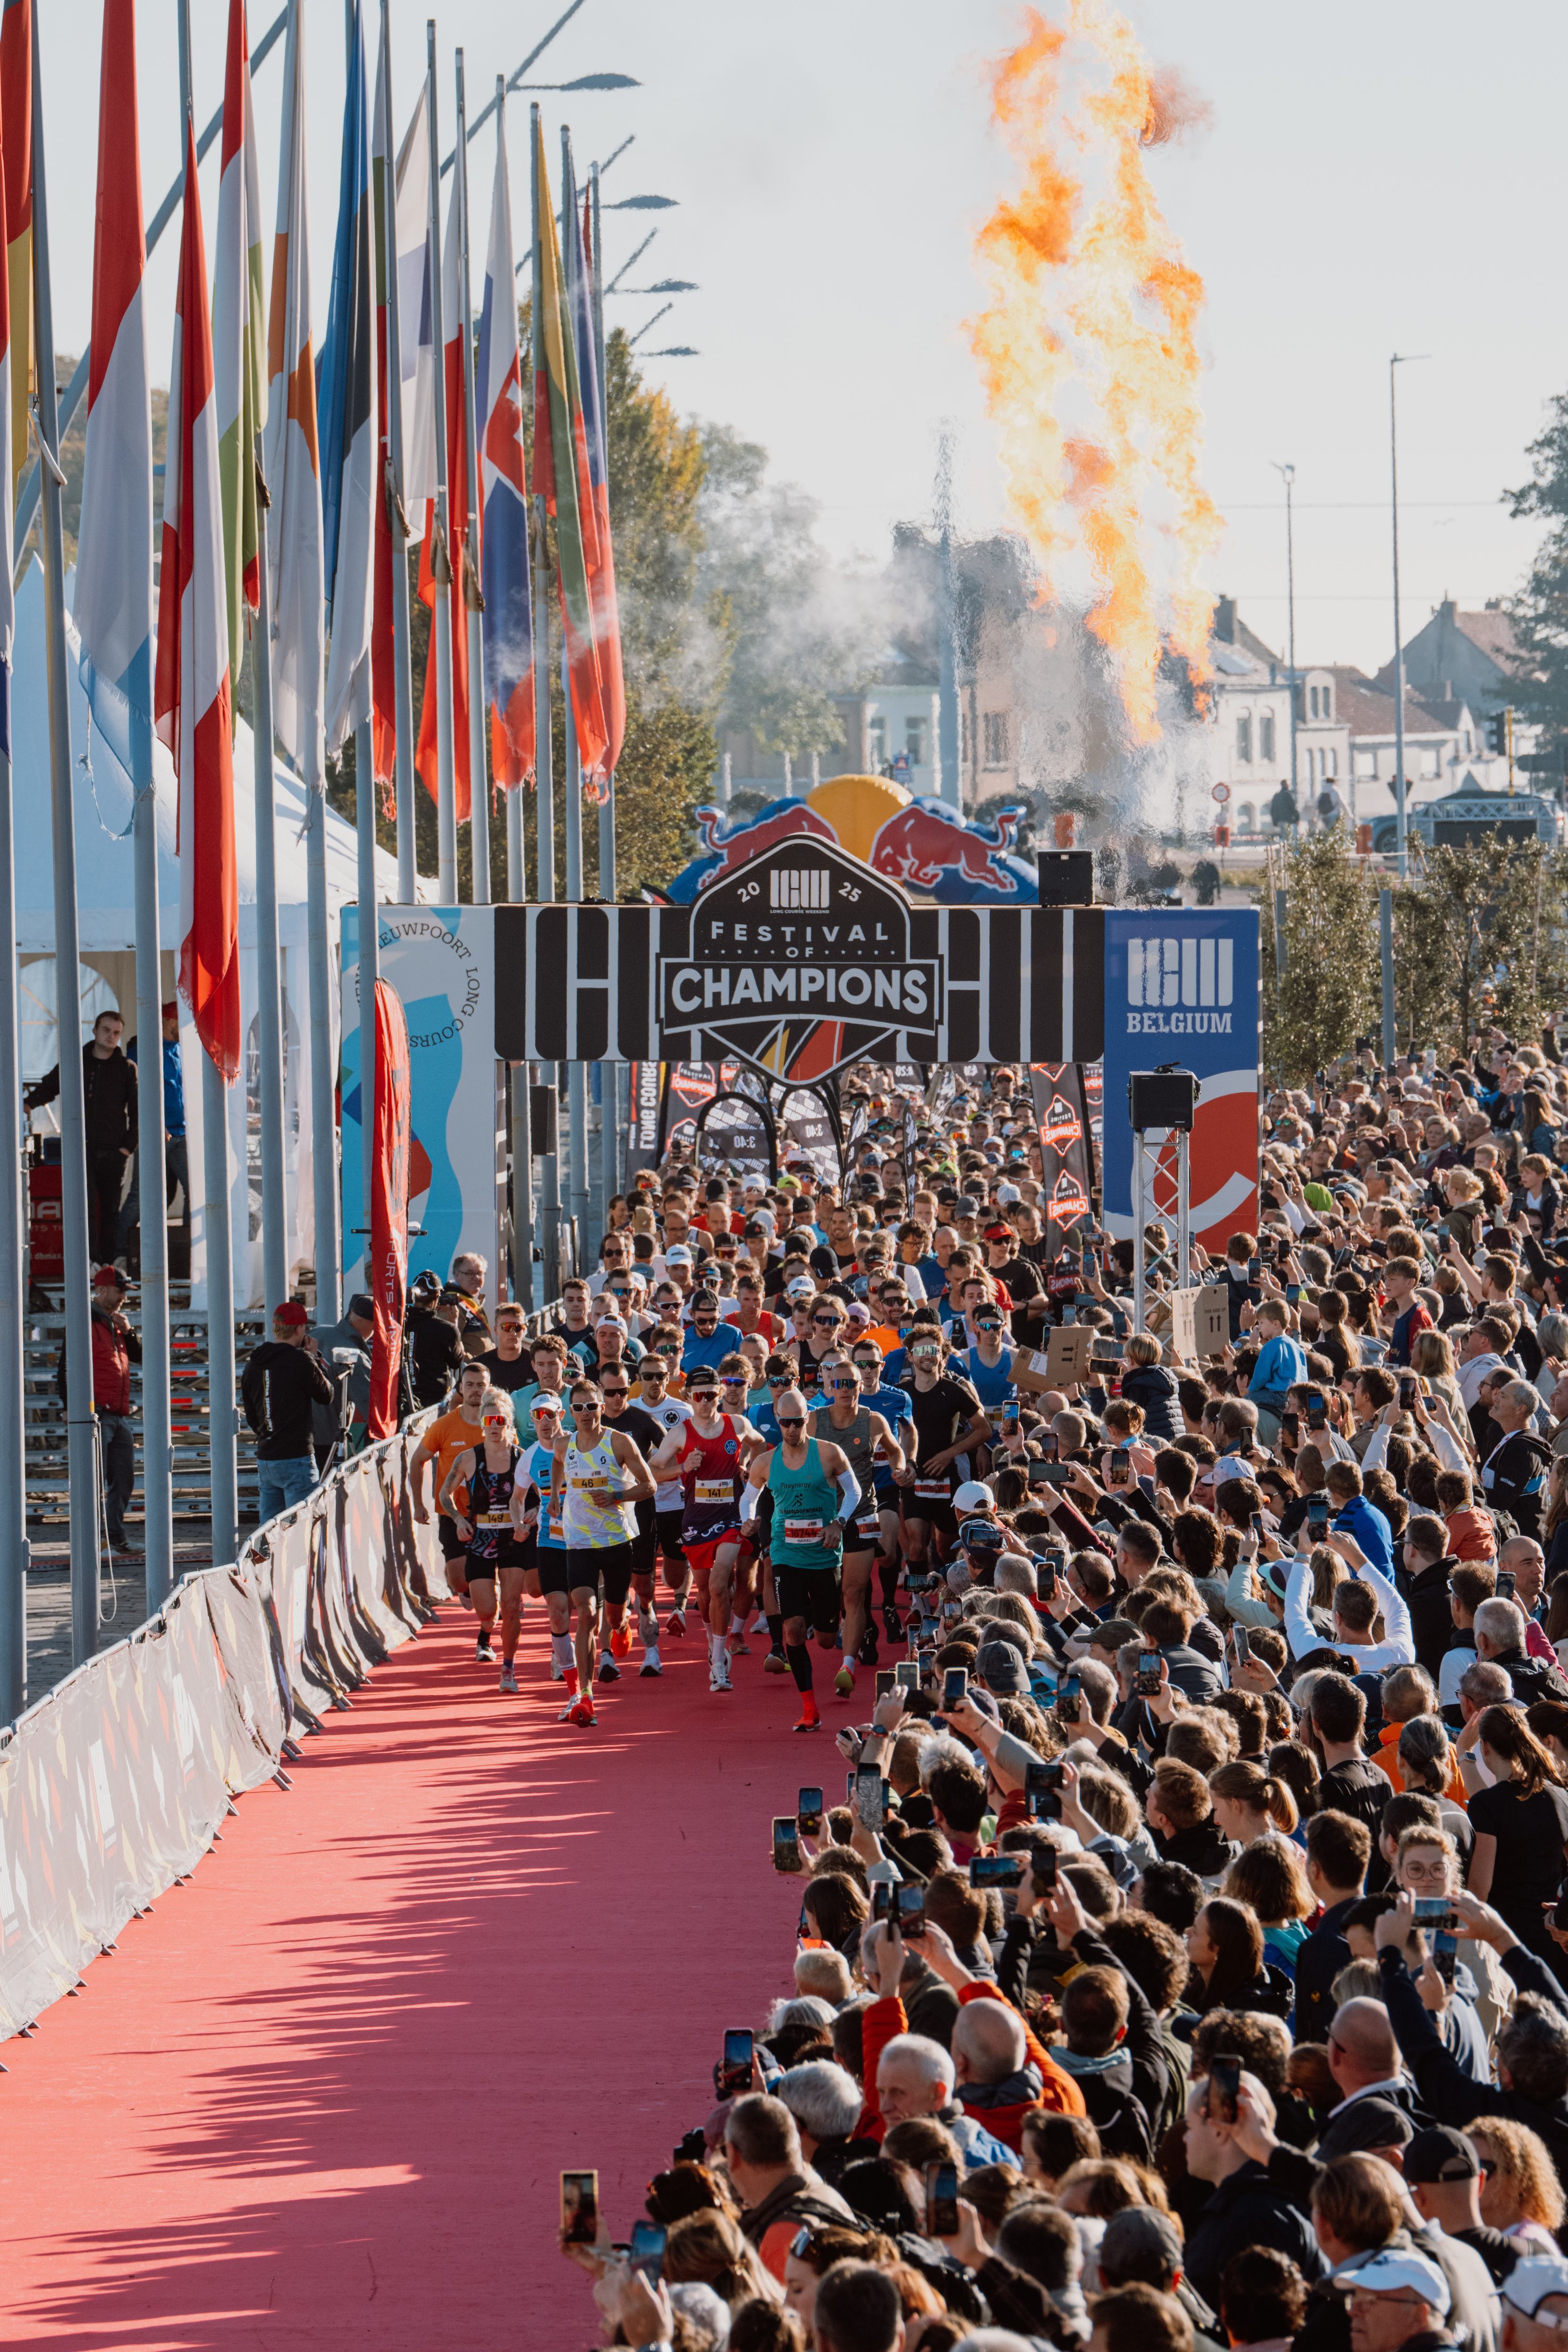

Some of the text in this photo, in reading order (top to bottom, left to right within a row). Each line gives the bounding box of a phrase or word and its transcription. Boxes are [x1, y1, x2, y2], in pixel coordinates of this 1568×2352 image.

[737, 882, 760, 902] 20
[838, 882, 862, 902] 25
[711, 921, 888, 942] FESTIVAL
[786, 947, 813, 958] OF
[461, 967, 480, 1017] LONG
[671, 968, 928, 1014] CHAMPIONS
[410, 1018, 464, 1047] COURS
[1127, 1012, 1232, 1033] BELGIUM
[581, 1479, 594, 1488] 46
[708, 1489, 721, 1497] 141
[488, 1514, 503, 1523] 149
[791, 1529, 818, 1538] 16744
